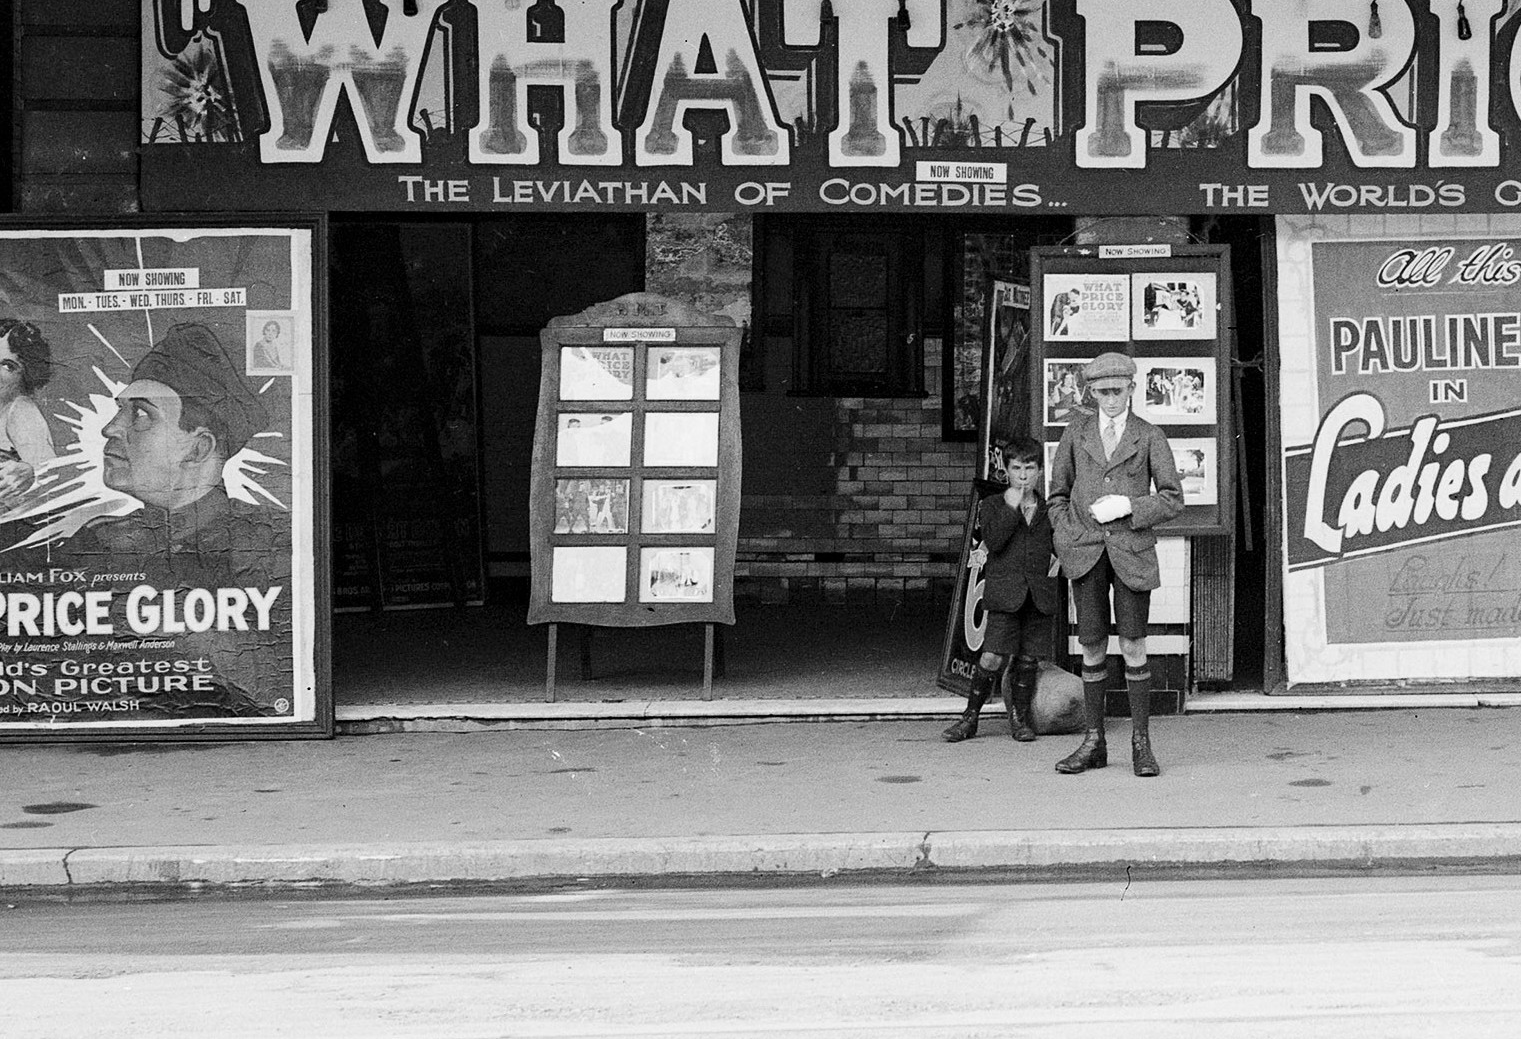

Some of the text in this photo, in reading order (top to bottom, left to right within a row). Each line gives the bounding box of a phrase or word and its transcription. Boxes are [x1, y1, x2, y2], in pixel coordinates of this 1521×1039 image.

[930, 165, 995, 180] NOW SHOWING
[397, 175, 470, 203] THE
[492, 175, 708, 205] LEVIATHAN
[734, 181, 792, 206] OF
[1199, 183, 1269, 208] THE
[1105, 247, 1167, 256] NOW SHOWING
[1376, 245, 1456, 289] All
[118, 272, 186, 287] NOW SHOWING
[1083, 282, 1122, 292] WHAT
[1082, 292, 1125, 302] PRICE
[1082, 301, 1125, 312] GLORY
[610, 330, 672, 339] NOW SHOWING
[1429, 378, 1469, 404] IN
[1302, 392, 1492, 554] Ladies
[91, 572, 148, 588] presents
[126, 584, 283, 635] GLORY
[60, 657, 213, 676] Greatest
[54, 674, 215, 696] PICTURE
[13, 703, 24, 717] by
[27, 701, 82, 714] RAOUL
[86, 699, 141, 712] WALSH
